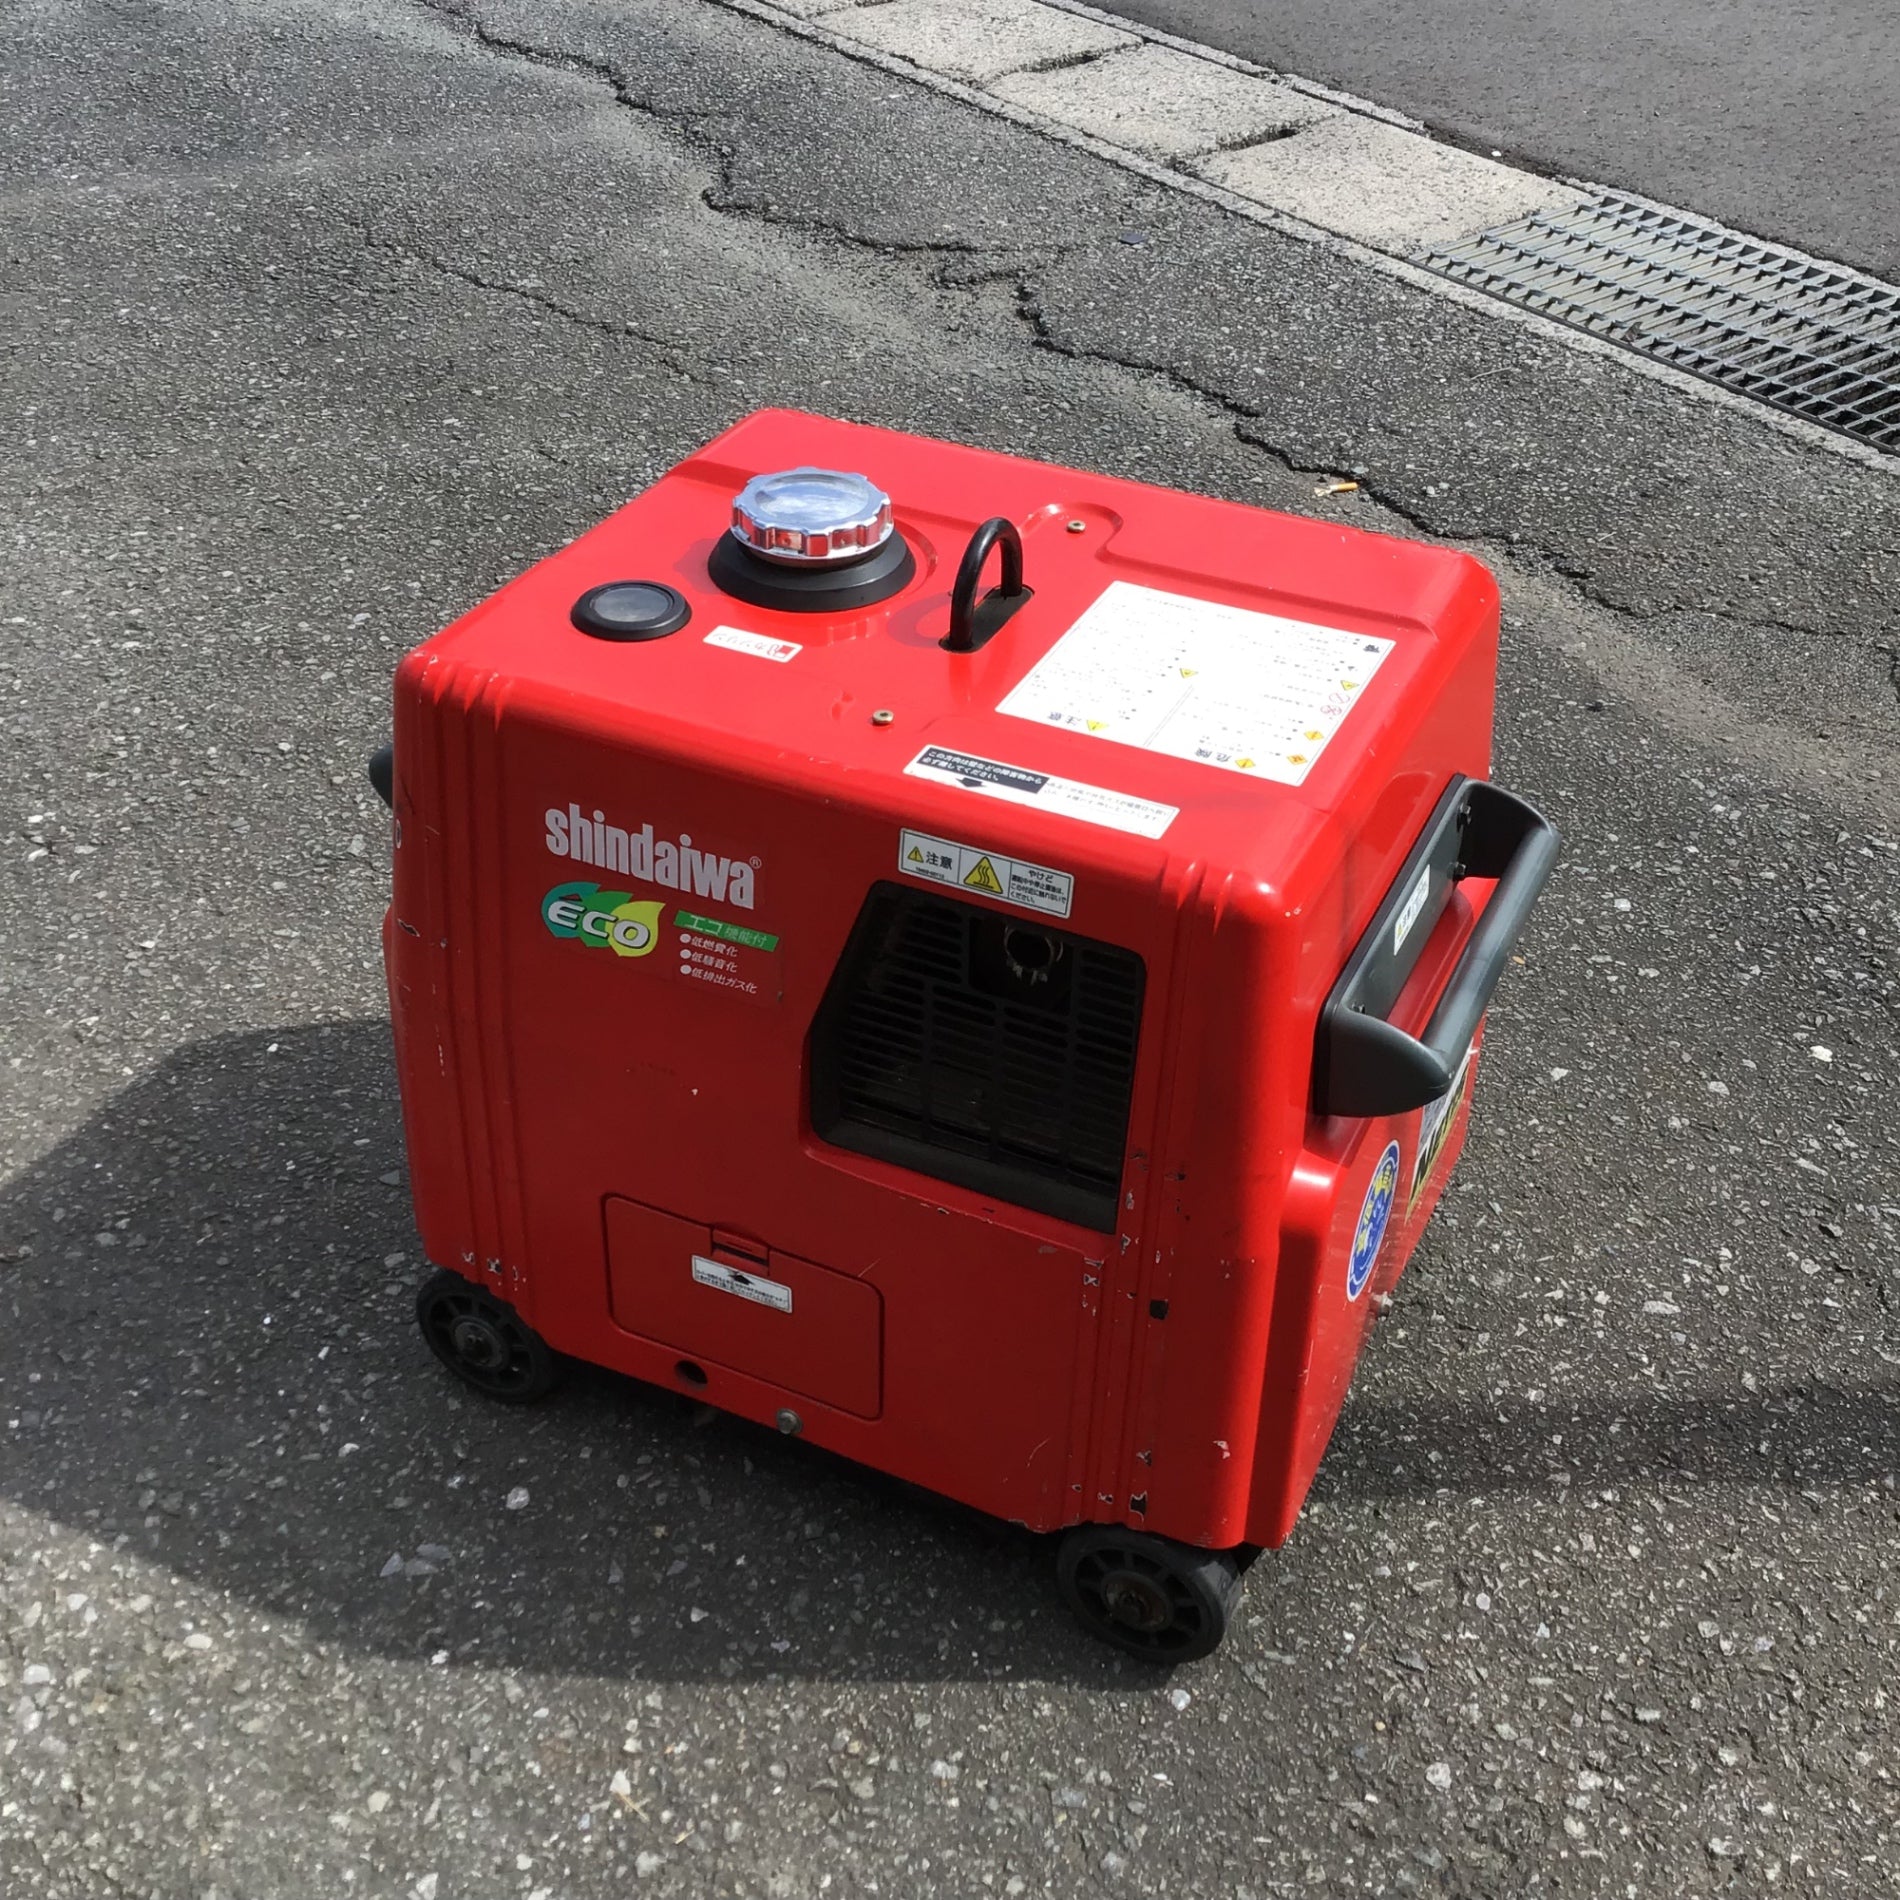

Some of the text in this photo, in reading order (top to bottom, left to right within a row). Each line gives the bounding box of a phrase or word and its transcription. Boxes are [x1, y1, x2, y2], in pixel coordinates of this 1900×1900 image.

[925, 850, 953, 870] 注意
[1028, 869, 1054, 883] やけど
[547, 900, 651, 948] ECO
[684, 914, 767, 947] エコ機能付
[691, 936, 738, 957] 低燃費化
[691, 951, 738, 973] 低騒音化
[691, 967, 758, 994] 低排出ガス化
